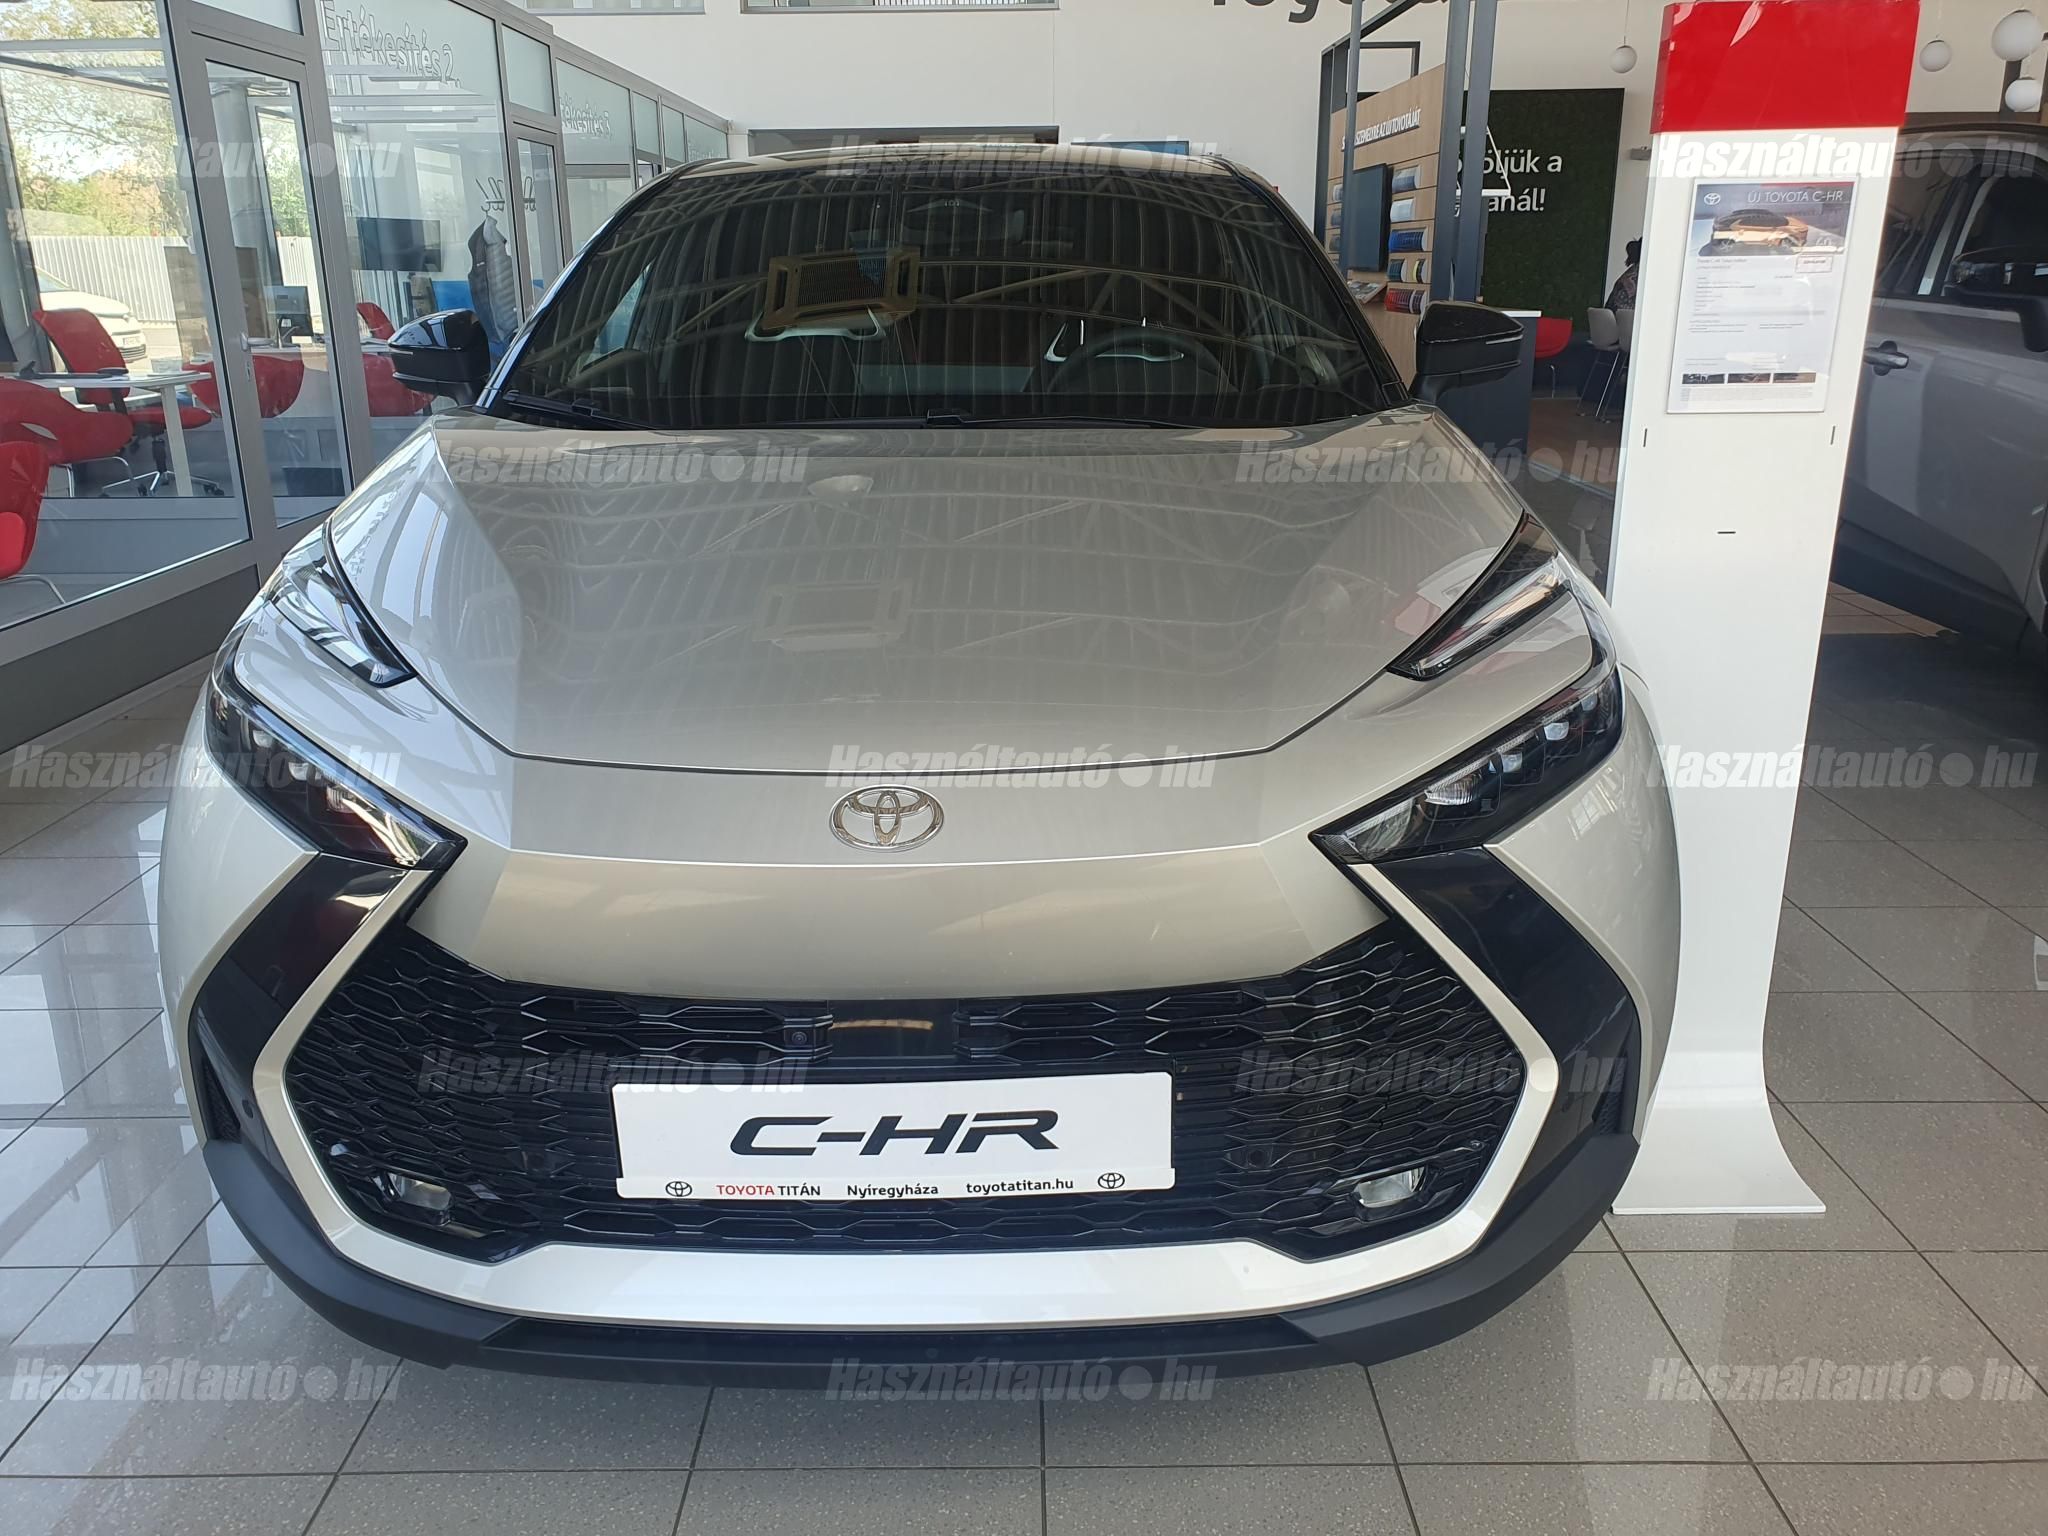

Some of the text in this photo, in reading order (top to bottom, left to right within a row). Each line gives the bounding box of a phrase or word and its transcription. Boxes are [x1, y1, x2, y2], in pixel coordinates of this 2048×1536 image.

[1547, 155, 1563, 173] a
[1765, 191, 1809, 203] TOYOTA
[1812, 190, 1843, 202] C-HR
[730, 1110, 1060, 1156] C-HR
[716, 1178, 1074, 1199] TOYOTA TITÁN Nyíregyháza toyotatitan.hu
